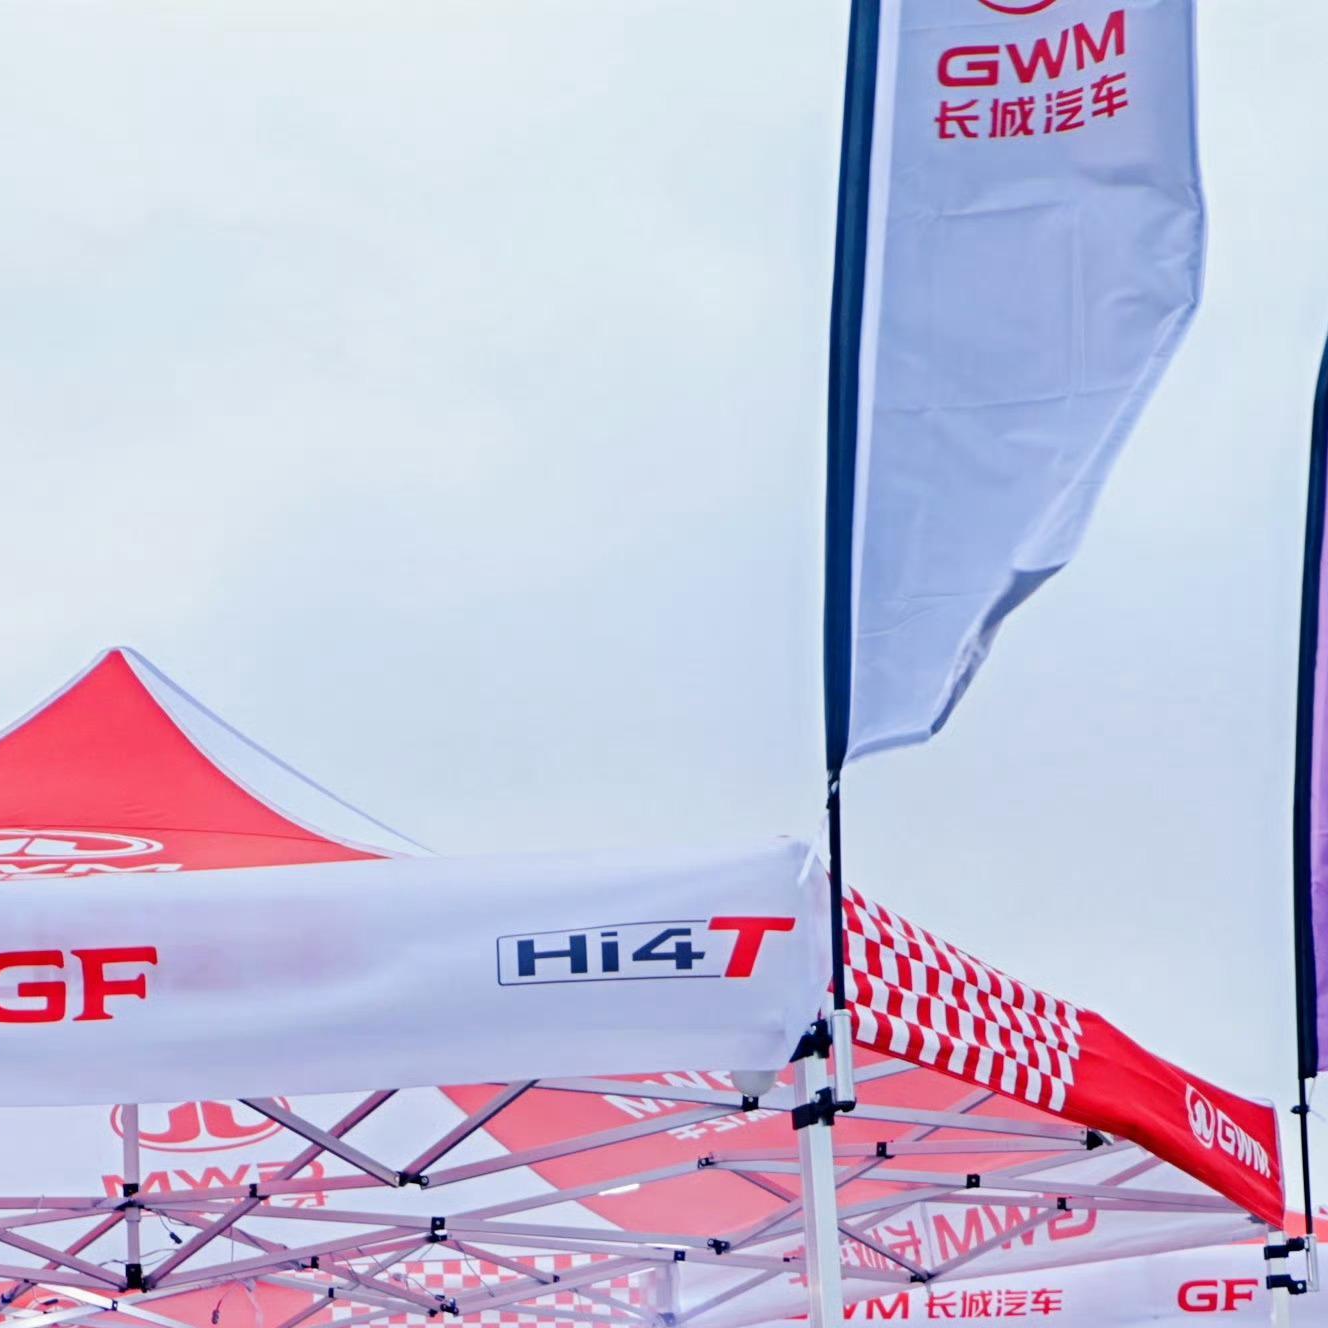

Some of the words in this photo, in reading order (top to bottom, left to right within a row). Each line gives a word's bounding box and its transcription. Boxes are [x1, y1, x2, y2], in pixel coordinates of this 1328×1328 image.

[936, 9, 1127, 88] GWM
[934, 72, 1129, 140] 长城汽车
[516, 915, 796, 980] Hi4T
[1216, 1108, 1271, 1179] GWM
[924, 1287, 1064, 1320] 长城汽车
[1177, 1278, 1259, 1312] GF
